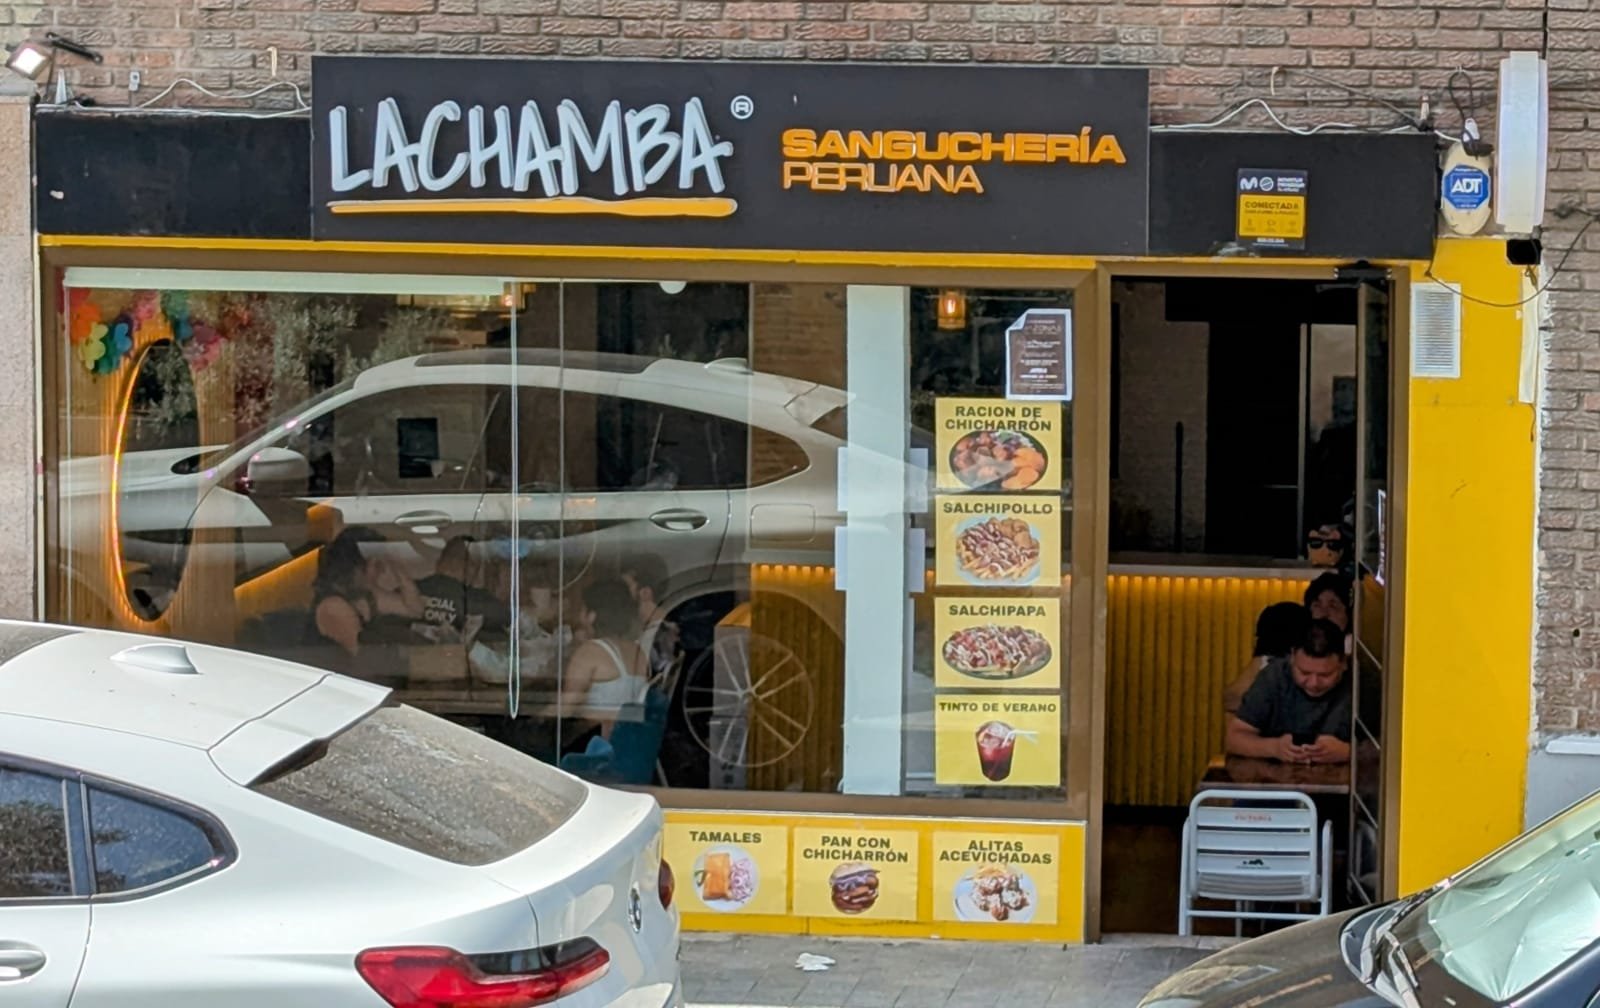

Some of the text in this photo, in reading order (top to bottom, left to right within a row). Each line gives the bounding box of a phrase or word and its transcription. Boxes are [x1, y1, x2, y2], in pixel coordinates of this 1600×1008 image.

[329, 96, 734, 197] LACHAMBA
[782, 125, 1127, 164] SANGUCHERÍA
[783, 161, 984, 194] PERUANA
[1451, 178, 1483, 194] ADT
[955, 406, 1042, 418] RACION DE
[945, 418, 1052, 432] CHICHARRÓN
[943, 502, 1053, 515] SALCHIPOLLO
[949, 605, 1046, 617] SALCHIPAPA
[939, 702, 1057, 713] TINTO DE VERANO
[690, 830, 762, 844] TAMALES
[821, 835, 891, 849] PAN CON
[968, 840, 1024, 852] ALITAS
[802, 848, 909, 863] CHICHARRÓN
[939, 851, 1053, 865] ACEVICHADAS
